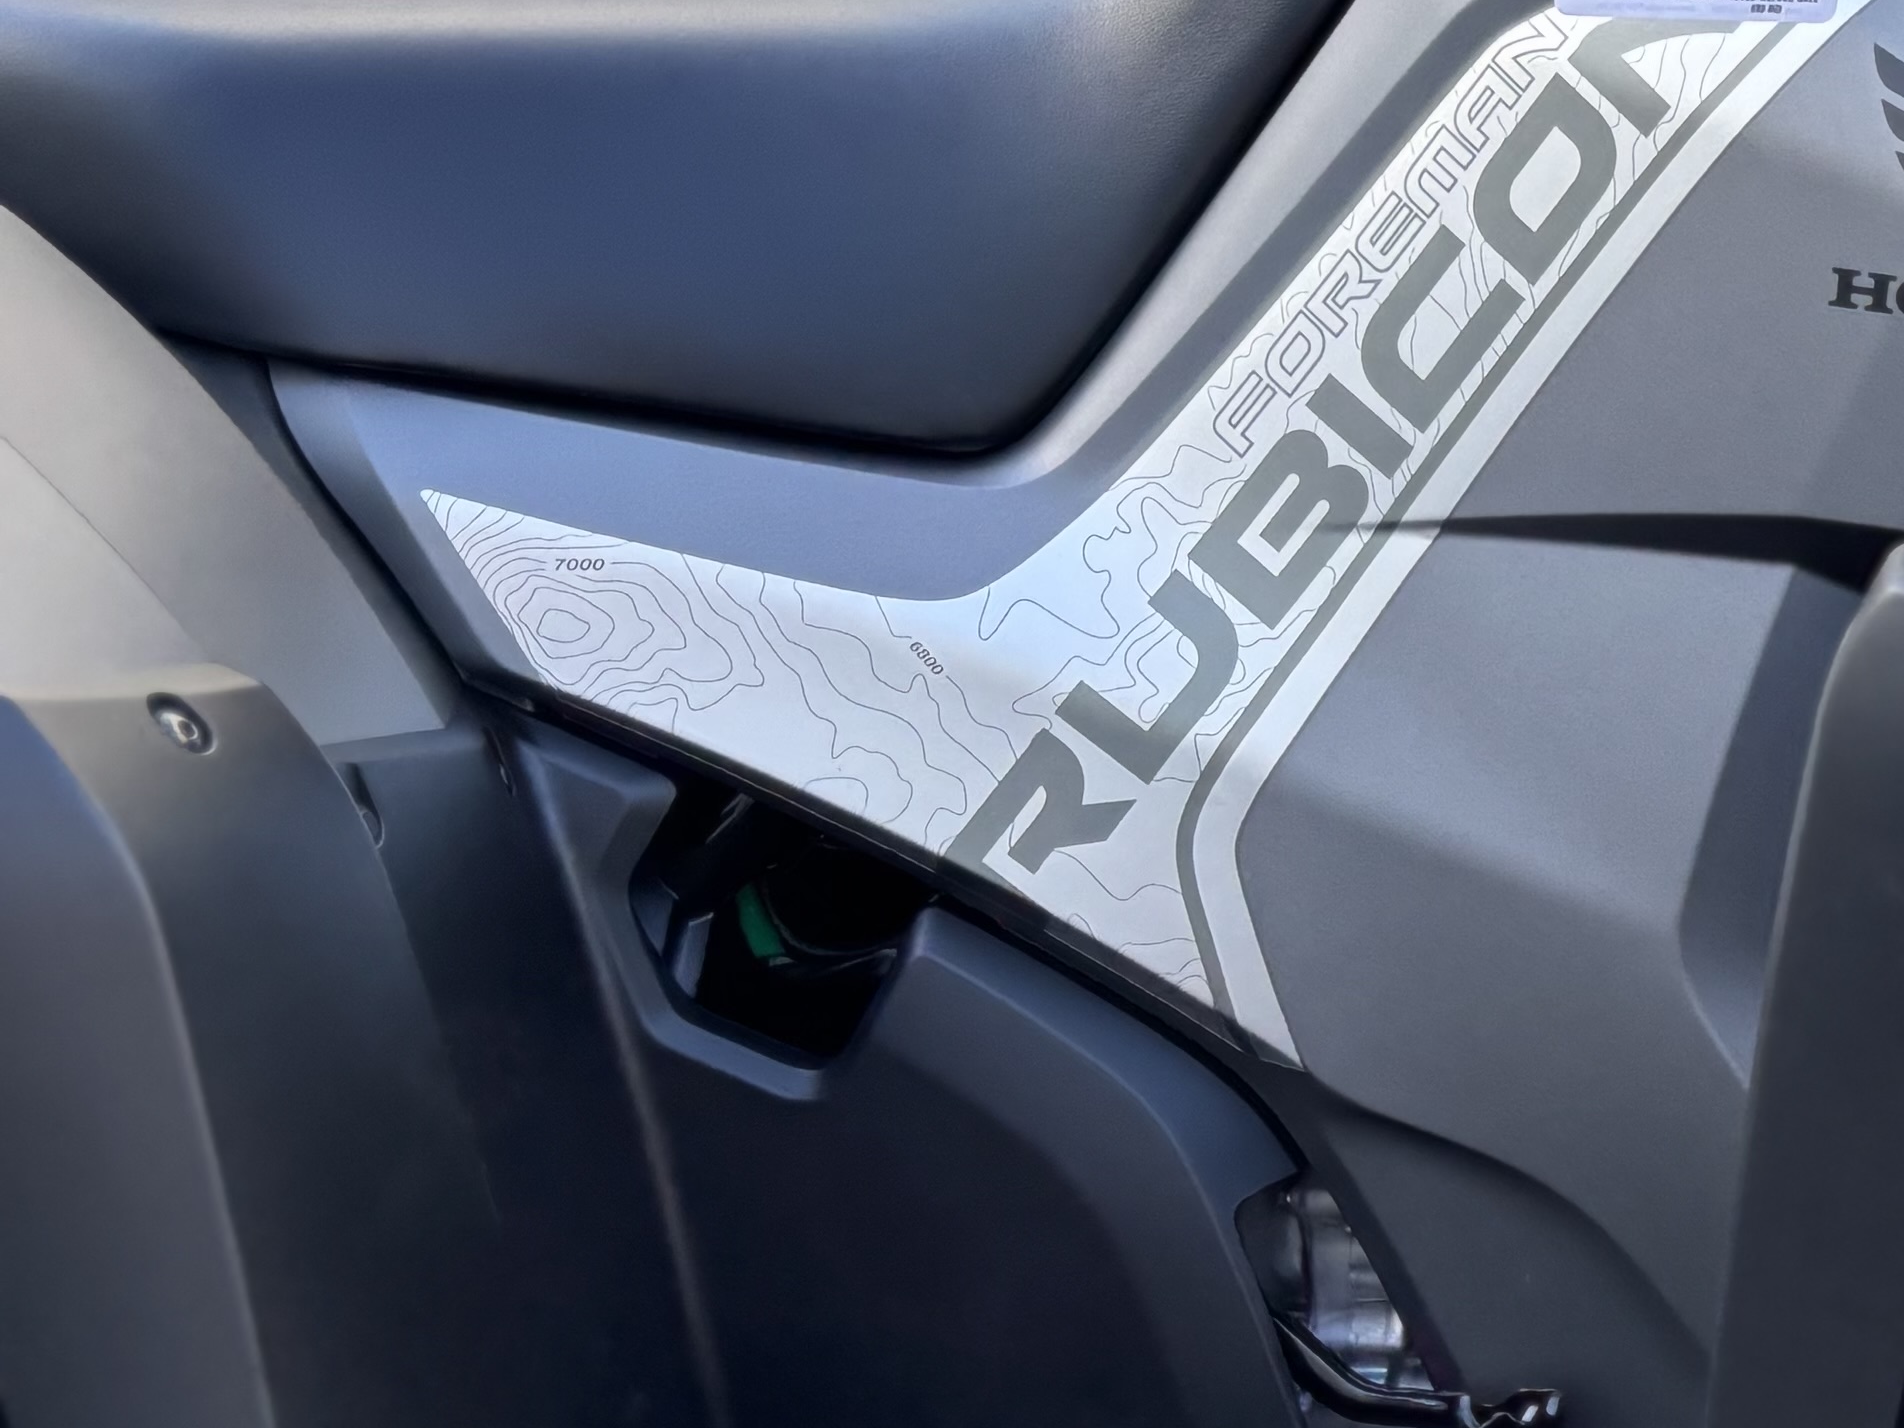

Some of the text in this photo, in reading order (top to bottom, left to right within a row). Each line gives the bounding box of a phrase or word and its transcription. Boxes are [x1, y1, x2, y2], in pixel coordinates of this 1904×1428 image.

[1213, 9, 1569, 457] FOREMAN
[555, 558, 605, 571] 7000
[909, 641, 944, 675] 6800
